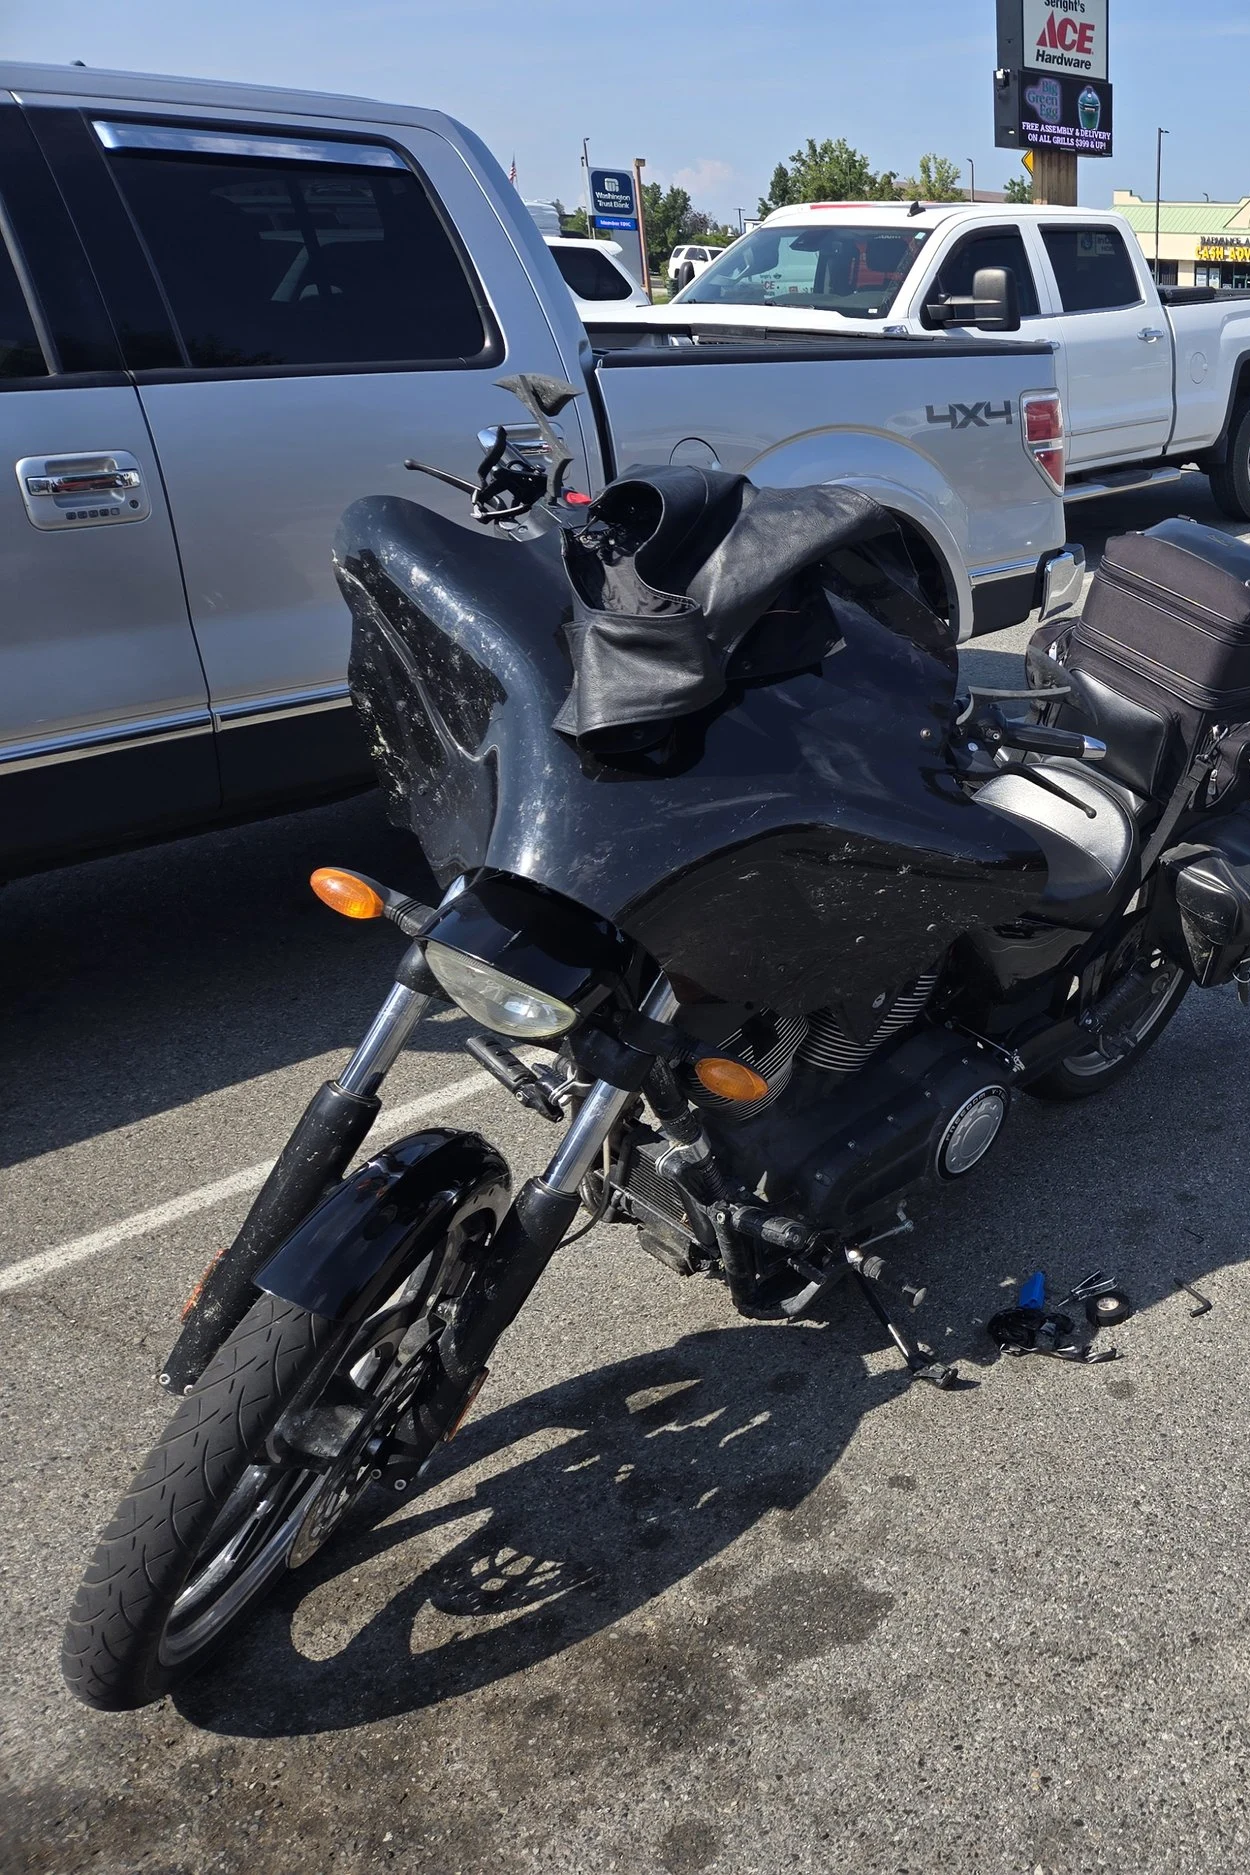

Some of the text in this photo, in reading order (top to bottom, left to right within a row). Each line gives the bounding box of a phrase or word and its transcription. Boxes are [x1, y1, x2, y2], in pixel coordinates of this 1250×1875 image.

[1036, 10, 1095, 55] ACE
[1036, 49, 1092, 70] Hardware
[1042, 80, 1058, 96] Big
[1028, 90, 1058, 106] Green
[1022, 121, 1111, 140] FREE ASSEMBLY & DELIVERY
[1027, 133, 1038, 142] ON
[1039, 134, 1052, 144] ALL
[1052, 136, 1075, 147] GRILLS
[595, 191, 631, 202] Washington
[597, 200, 630, 209] Trust Bank
[1195, 245, 1224, 260] CASH
